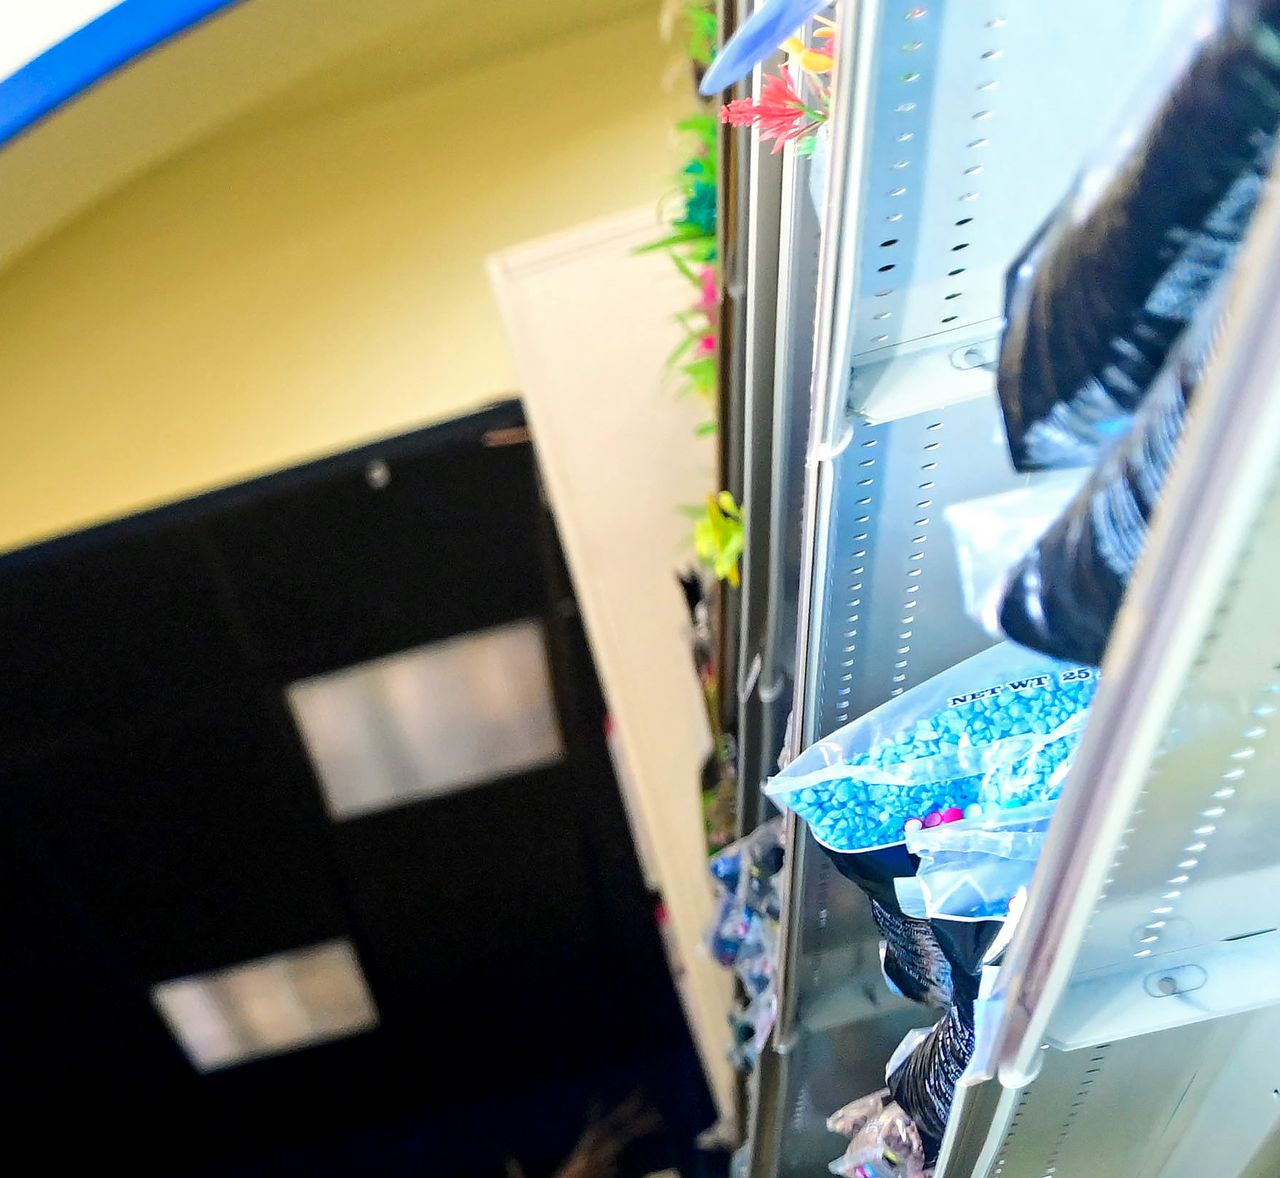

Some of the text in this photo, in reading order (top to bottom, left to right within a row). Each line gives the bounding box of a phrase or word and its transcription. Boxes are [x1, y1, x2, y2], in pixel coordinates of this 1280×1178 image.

[951, 668, 1091, 706] NET WT 25
